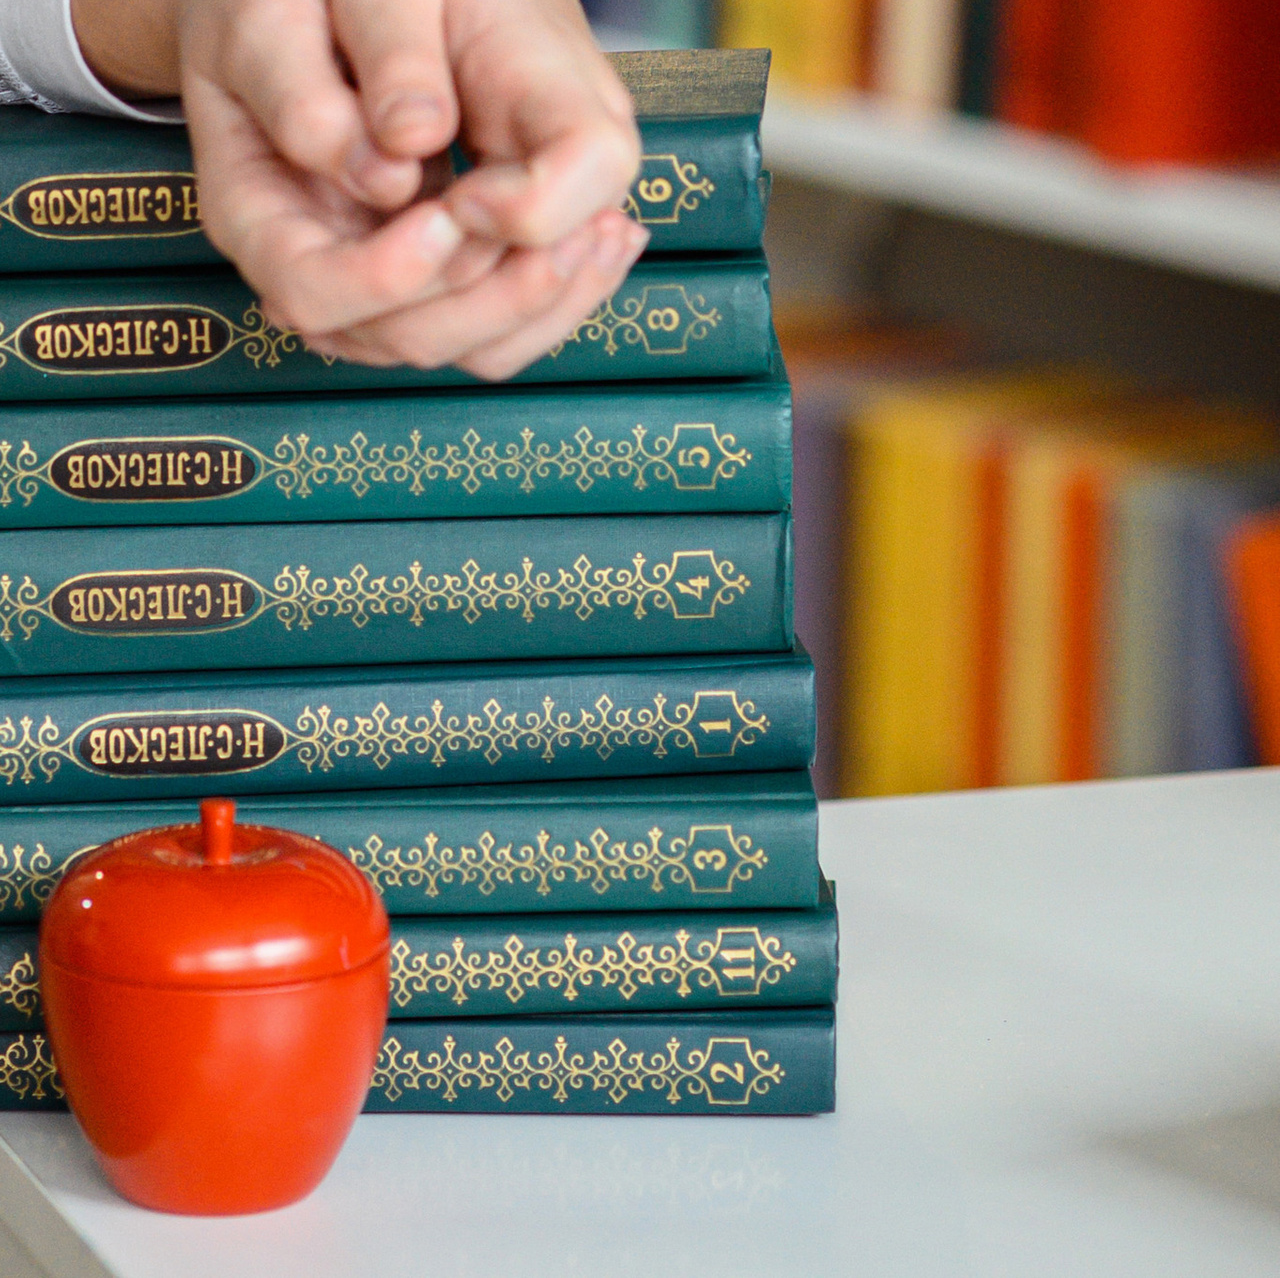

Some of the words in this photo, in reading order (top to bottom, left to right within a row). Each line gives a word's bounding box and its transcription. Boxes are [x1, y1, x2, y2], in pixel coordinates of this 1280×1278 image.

[638, 177, 673, 203] 6
[647, 306, 680, 331] 8
[678, 446, 711, 468] 5
[675, 575, 710, 600] 4
[699, 717, 731, 734] 1
[693, 848, 727, 872] 3
[720, 946, 755, 980] 11
[710, 1061, 744, 1085] 2
